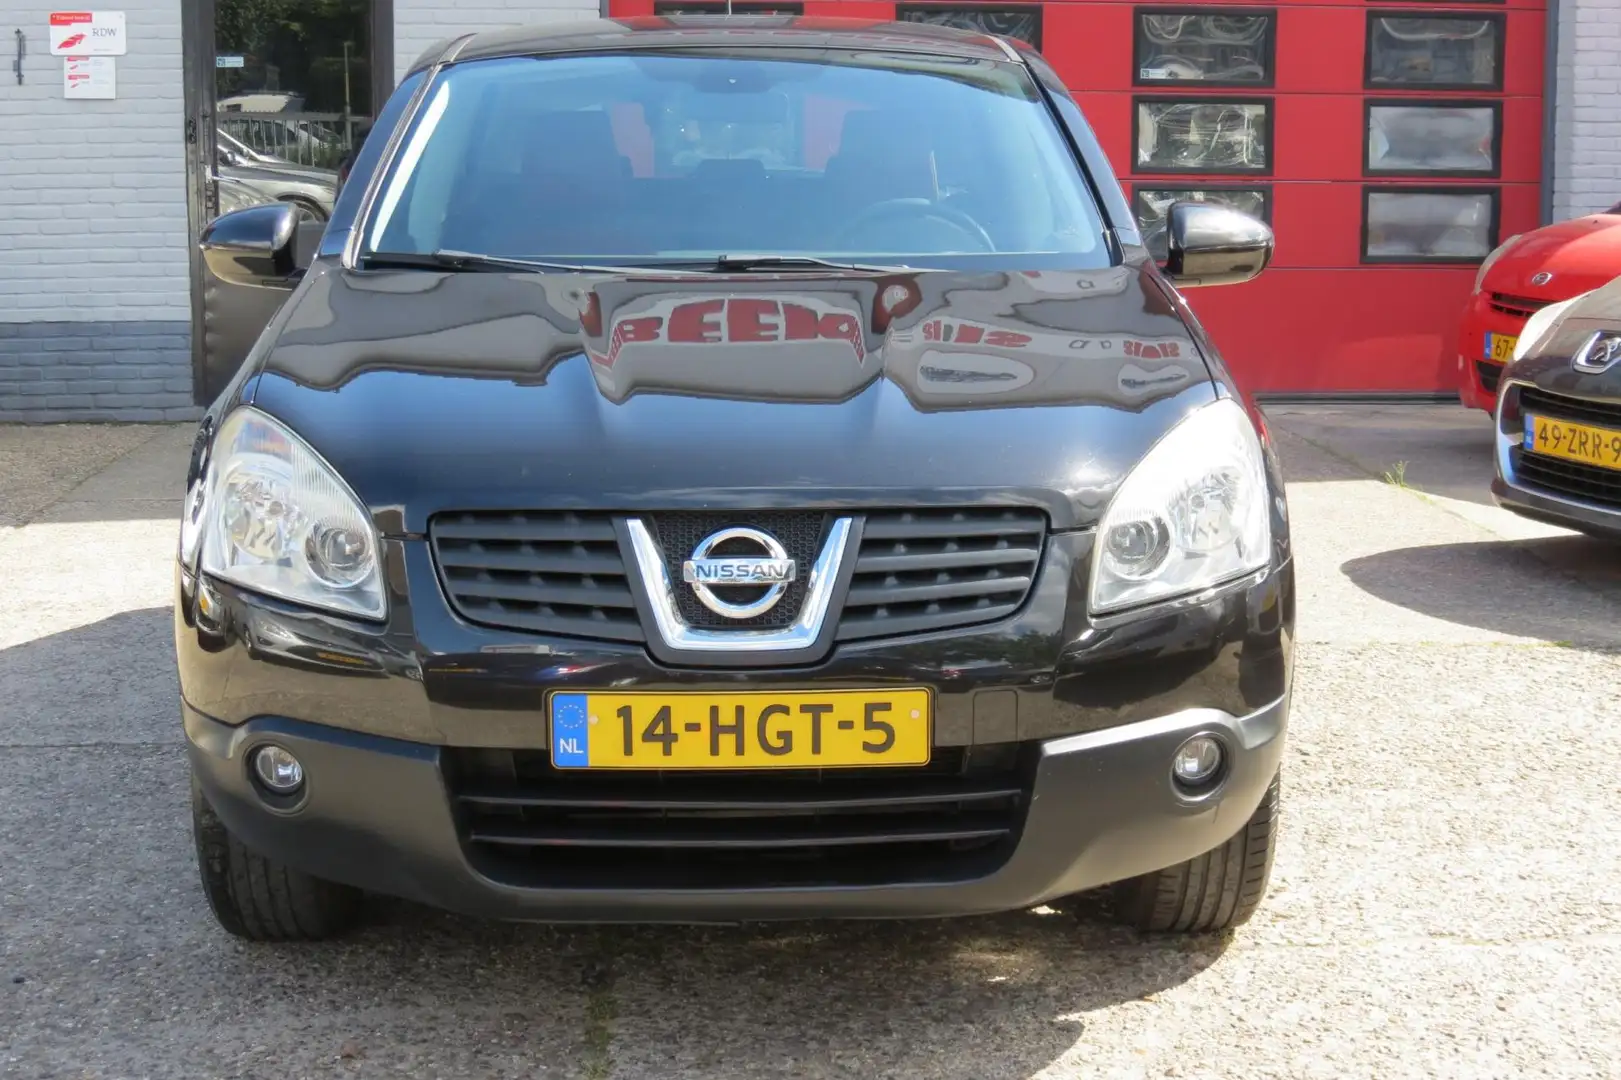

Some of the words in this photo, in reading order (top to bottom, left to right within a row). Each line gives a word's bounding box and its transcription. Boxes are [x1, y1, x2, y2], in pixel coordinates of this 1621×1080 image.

[92, 28, 117, 36] RDW
[1538, 422, 1621, 463] 49-ZRR-9
[696, 564, 784, 578] NISSAN
[559, 738, 584, 754] NL
[616, 702, 896, 757] 14-HGT-5
